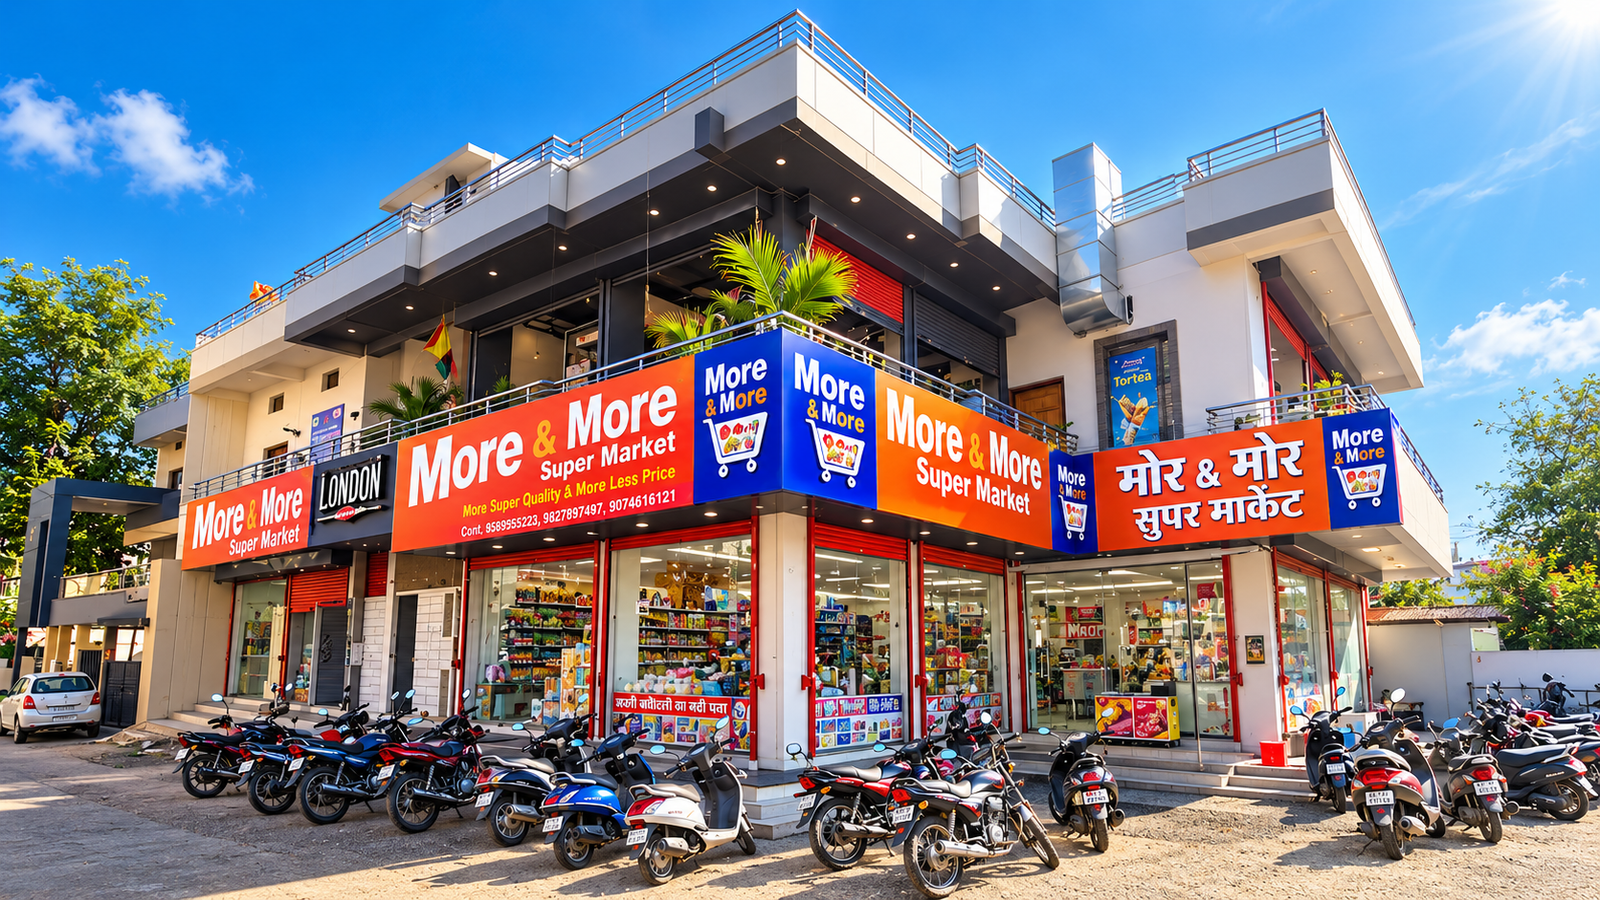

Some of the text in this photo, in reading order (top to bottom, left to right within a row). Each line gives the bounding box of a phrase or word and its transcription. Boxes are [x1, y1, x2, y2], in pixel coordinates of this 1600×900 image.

[705, 358, 767, 396] More
[794, 352, 865, 410] More
[1113, 372, 1152, 387] Tortea
[705, 387, 767, 417] & More
[807, 399, 865, 433] & More
[408, 385, 677, 508] More & More
[540, 431, 676, 482] Super Market
[886, 387, 1042, 490] More & More
[1332, 428, 1383, 450] More
[1334, 447, 1385, 465] & More
[1058, 464, 1086, 486] More
[1116, 431, 1304, 496] मोर & मोर
[462, 504, 487, 518] More
[490, 497, 520, 514] Super
[523, 488, 561, 506] Quality
[576, 481, 606, 497] More
[610, 475, 638, 490] Less
[642, 466, 676, 484] Price
[916, 456, 1030, 516] Super Market
[192, 486, 303, 550] More & More
[543, 502, 606, 524] 9827897497,
[609, 489, 676, 512] 9074616121
[1133, 501, 1202, 541] सुपर
[229, 524, 300, 557] Super Market
